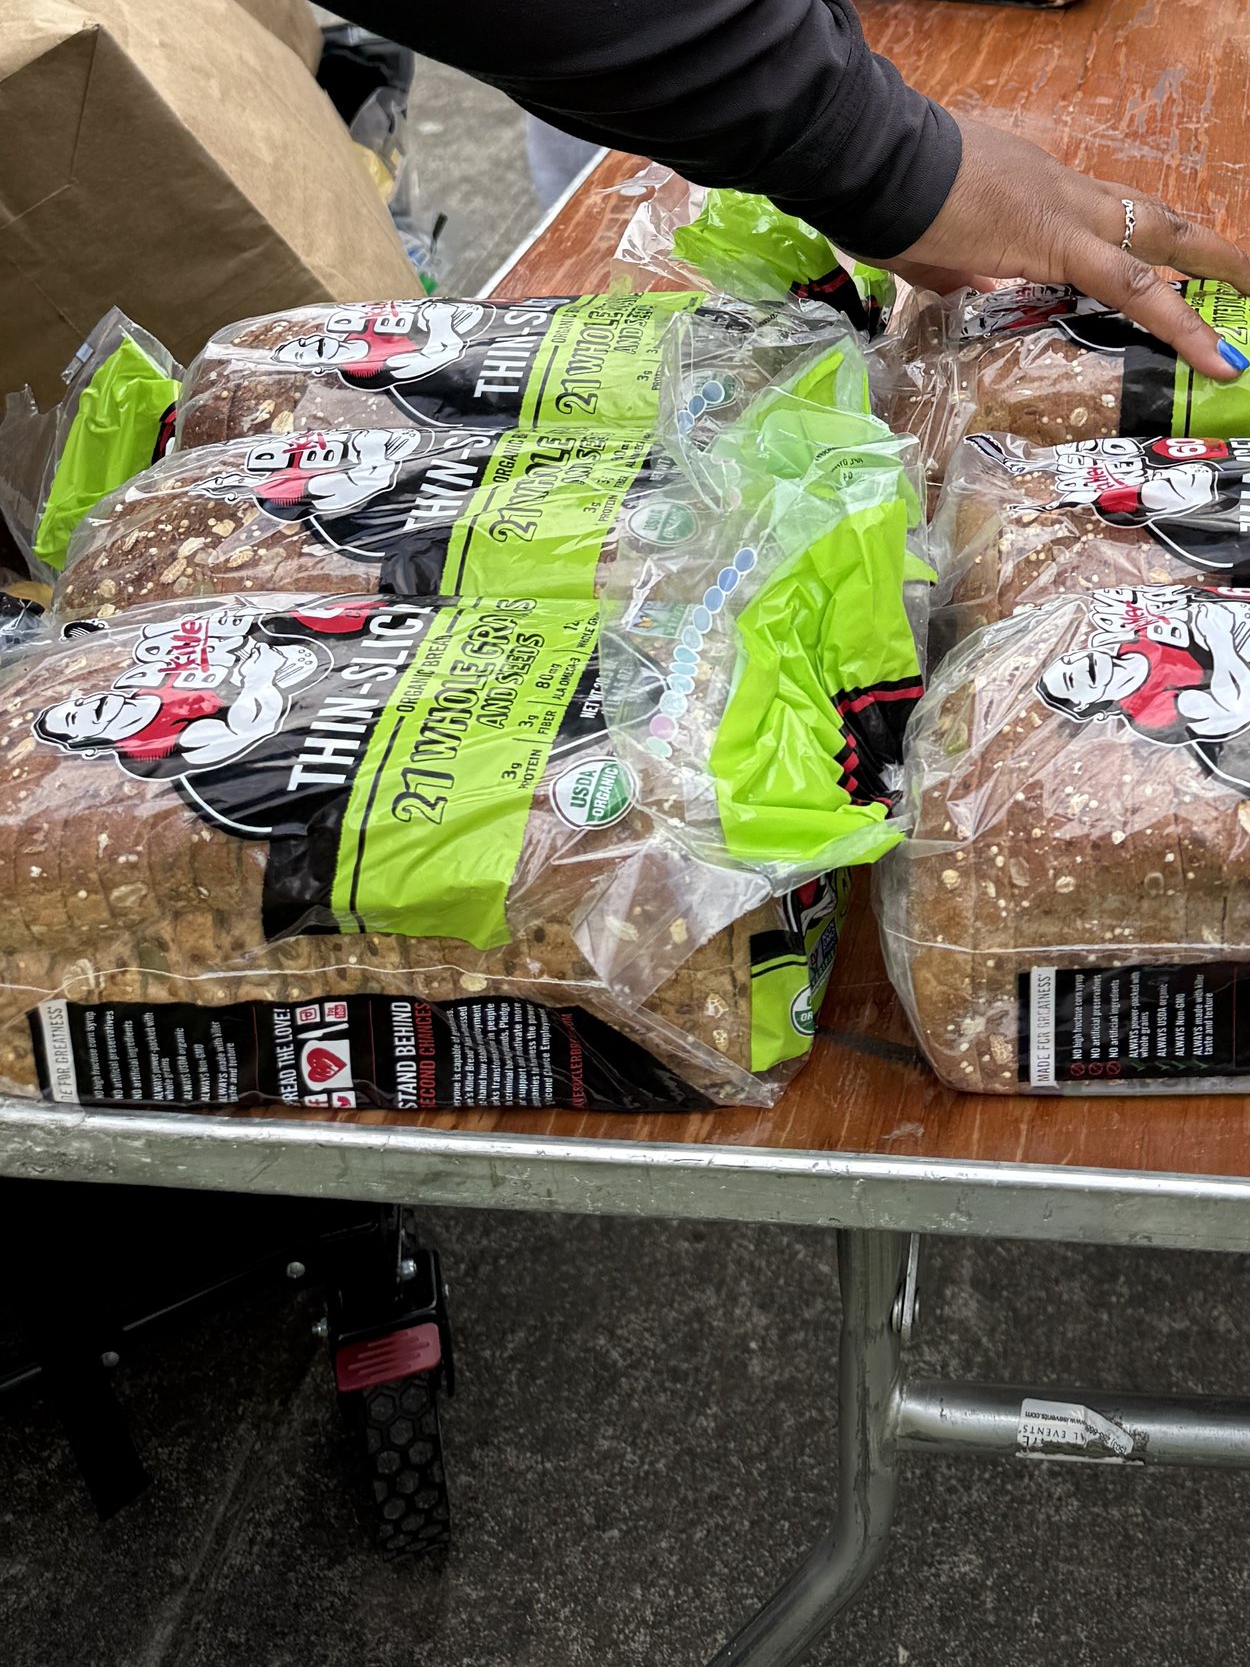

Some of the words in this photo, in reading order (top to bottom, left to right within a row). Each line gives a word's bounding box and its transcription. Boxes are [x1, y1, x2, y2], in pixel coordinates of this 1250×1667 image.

[551, 314, 578, 343] ORGANIC
[565, 310, 623, 375] WHOLE
[614, 327, 643, 354] AND
[555, 379, 601, 414] 21
[493, 440, 523, 482] ORGANIC
[489, 507, 543, 542] 21
[396, 670, 434, 712] ORGANIC
[422, 634, 453, 666] BREAD
[494, 633, 545, 685] SEEDS
[559, 657, 581, 686] OMEGA-3
[535, 663, 561, 689] 80mg
[410, 660, 496, 762] WHOLE
[476, 687, 518, 729] AND
[518, 715, 538, 728] 3g
[538, 710, 557, 735] FIBER
[580, 703, 602, 718] NET
[501, 762, 522, 780] 3g
[518, 749, 543, 789] PROTEIN
[392, 767, 455, 825] 21
[569, 769, 597, 808] USDA
[591, 766, 620, 817] ORGANIC
[1091, 974, 1102, 1016] preservatives
[1109, 980, 1120, 1014] ingredients
[1175, 993, 1185, 1025] Non-GMO
[1204, 992, 1214, 1018] texture
[273, 1008, 293, 1043] LOVE!
[1140, 1012, 1151, 1033] grains
[1157, 1007, 1167, 1026] USDA
[1194, 1004, 1203, 1024] made
[1204, 1020, 1214, 1034] and
[391, 1002, 416, 1056] BEHIND
[414, 1003, 435, 1056] CHANCES
[1037, 1032, 1050, 1050] FOR
[1072, 1034, 1084, 1047] high
[1091, 1017, 1101, 1046] artificial
[1109, 1016, 1119, 1045] artificial
[1157, 1028, 1167, 1057] ALWAYS
[1175, 1027, 1185, 1056] ALWAYS
[1193, 1027, 1203, 1055] ALWAYS
[276, 1044, 295, 1068] THE
[1073, 1050, 1082, 1059] NO
[1091, 1048, 1101, 1058] NO
[1109, 1047, 1119, 1057] NO
[1129, 1030, 1139, 1058] ALWAYS
[1140, 1036, 1149, 1058] whole
[1205, 1036, 1214, 1055] taste
[57, 1067, 72, 1086] FOR
[1037, 1054, 1050, 1081] MADE
[397, 1061, 418, 1108] STAND
